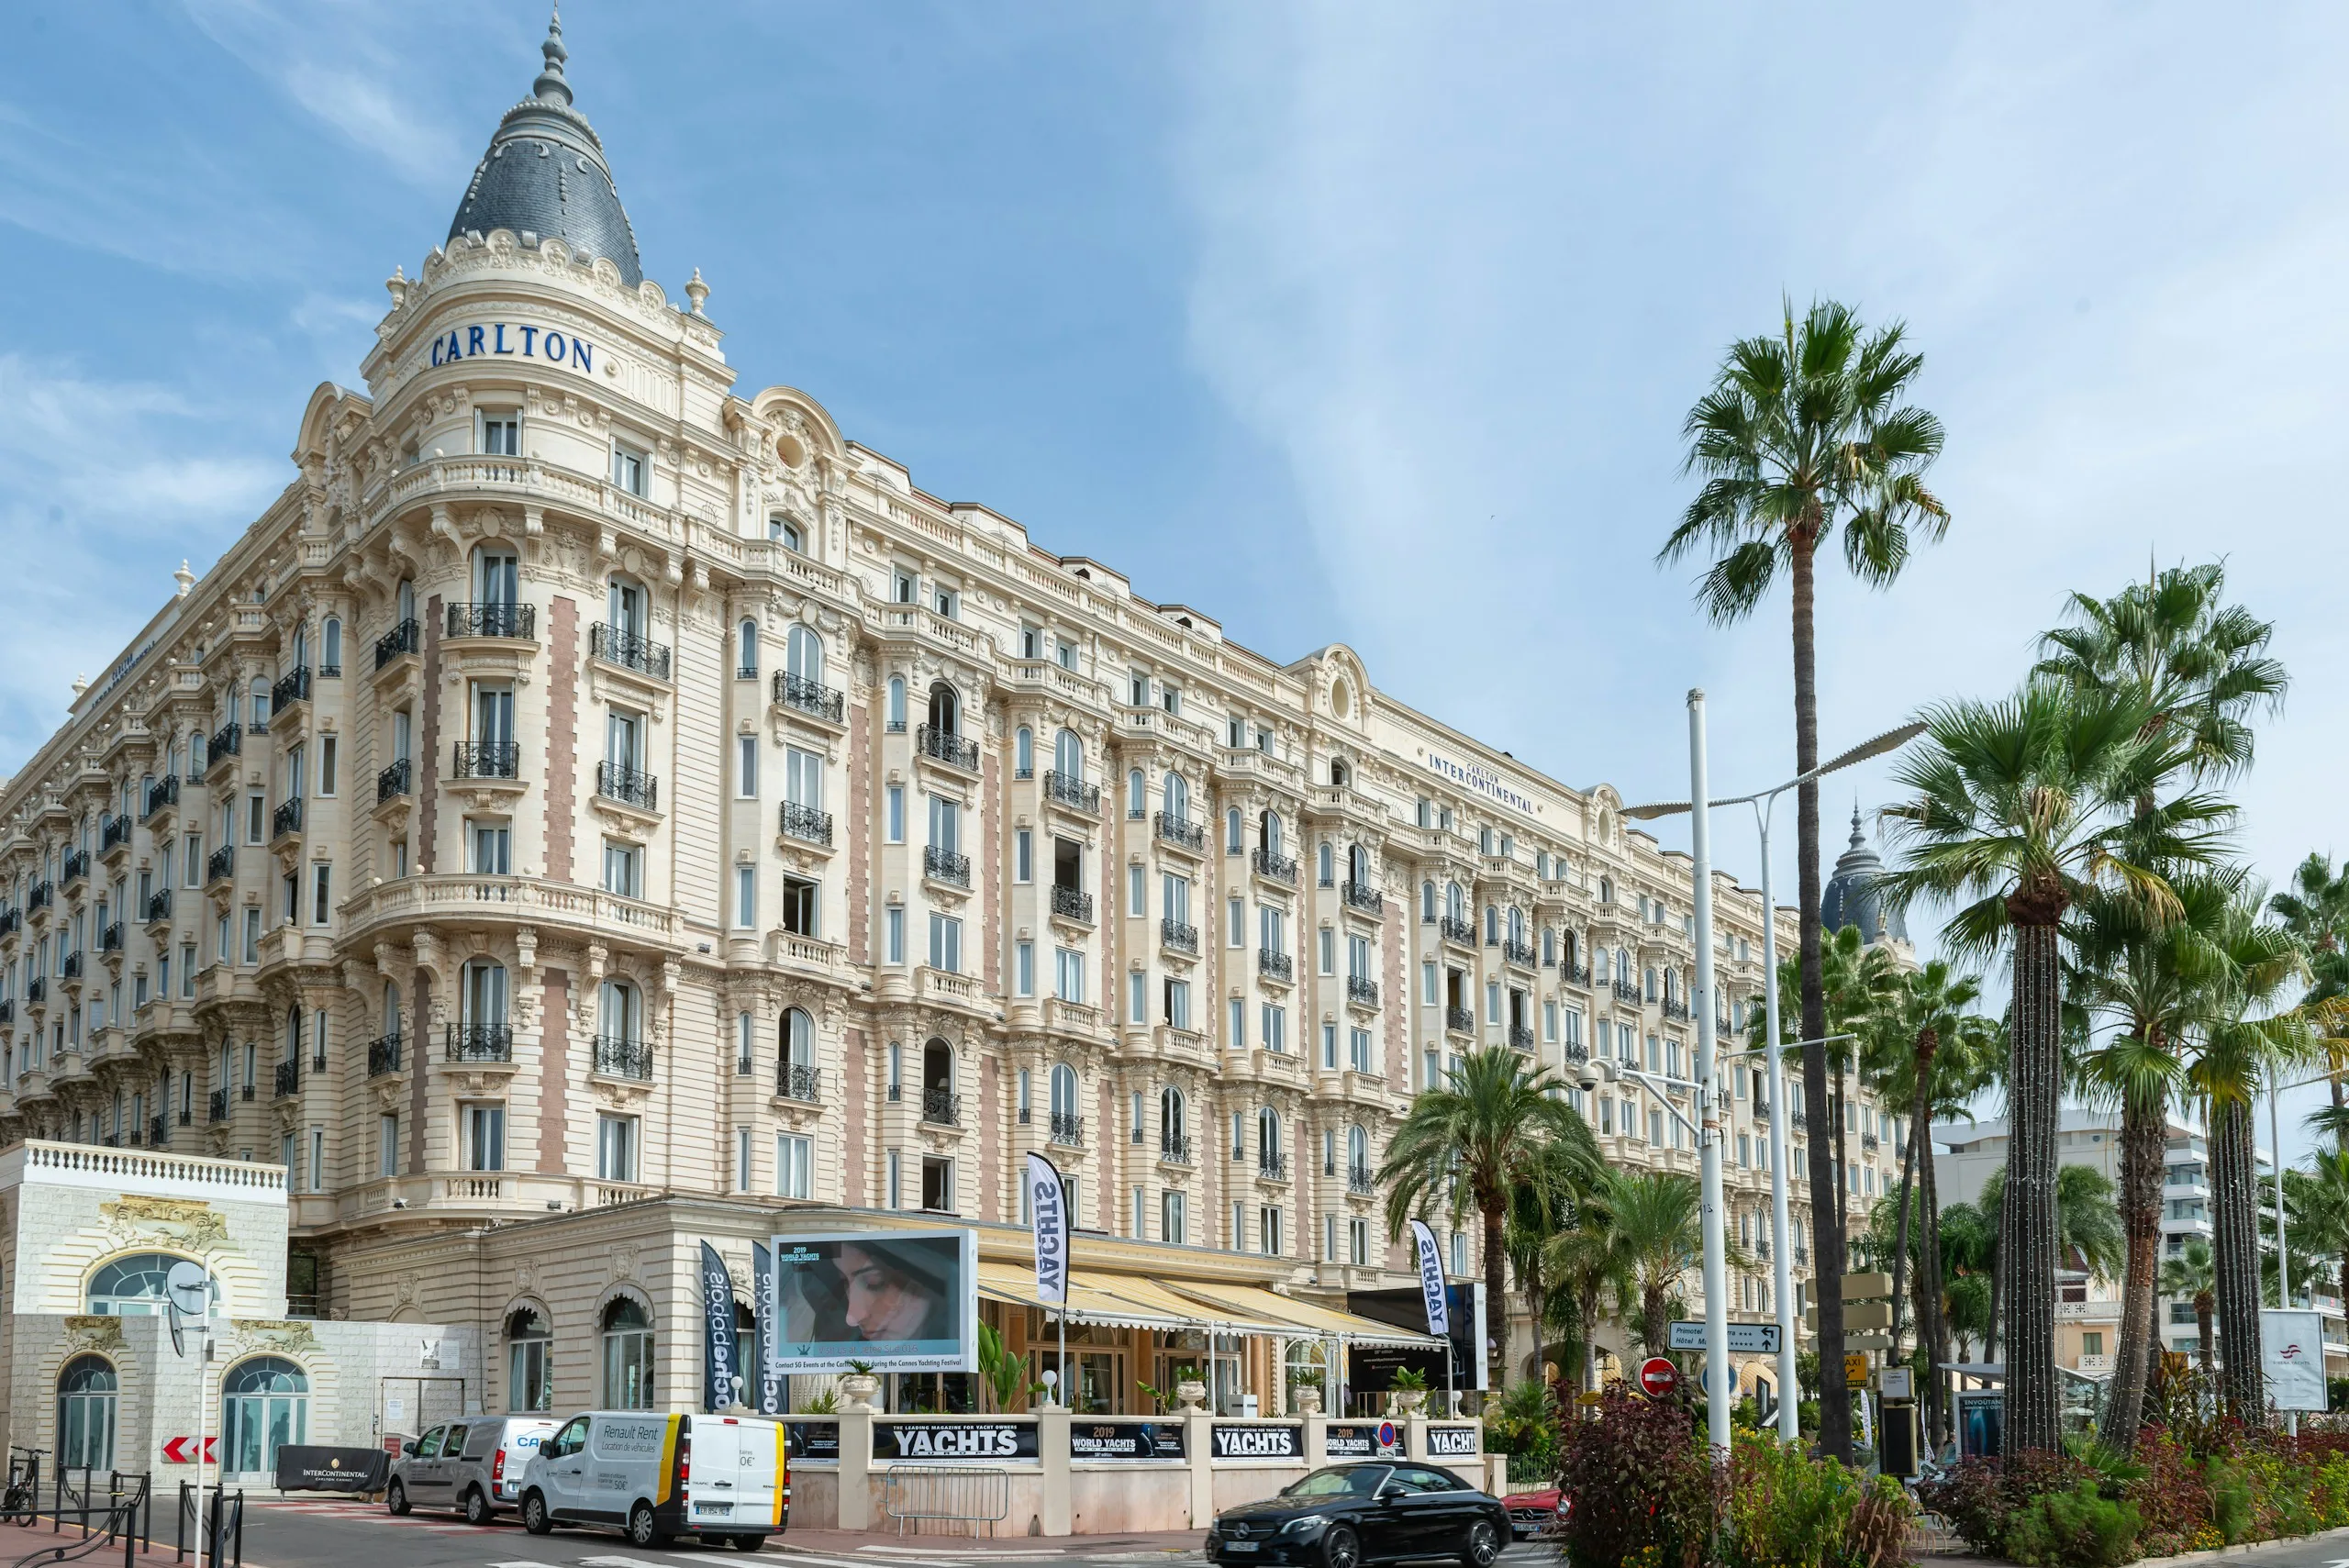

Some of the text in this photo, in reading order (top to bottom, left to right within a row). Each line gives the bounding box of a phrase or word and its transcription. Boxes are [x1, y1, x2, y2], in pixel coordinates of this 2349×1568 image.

[432, 324, 594, 373] CARLTON
[1467, 763, 1499, 784] CARLTON
[1429, 753, 1533, 815] INTERCONTINENTAL
[1675, 1327, 1703, 1335] Primotel
[918, 1359, 941, 1367] Yachting
[1845, 1358, 1861, 1366] AXI
[603, 1425, 659, 1440] Renault Rent
[1093, 1427, 1115, 1438] 2019
[1337, 1429, 1353, 1438] 2019
[601, 1441, 656, 1453] Location de véhicules
[893, 1429, 1019, 1456] YACHTS
[1072, 1438, 1136, 1448] WORLD YACHTS
[1216, 1432, 1292, 1455] YACHTS
[1345, 1439, 1369, 1447] YACHTS
